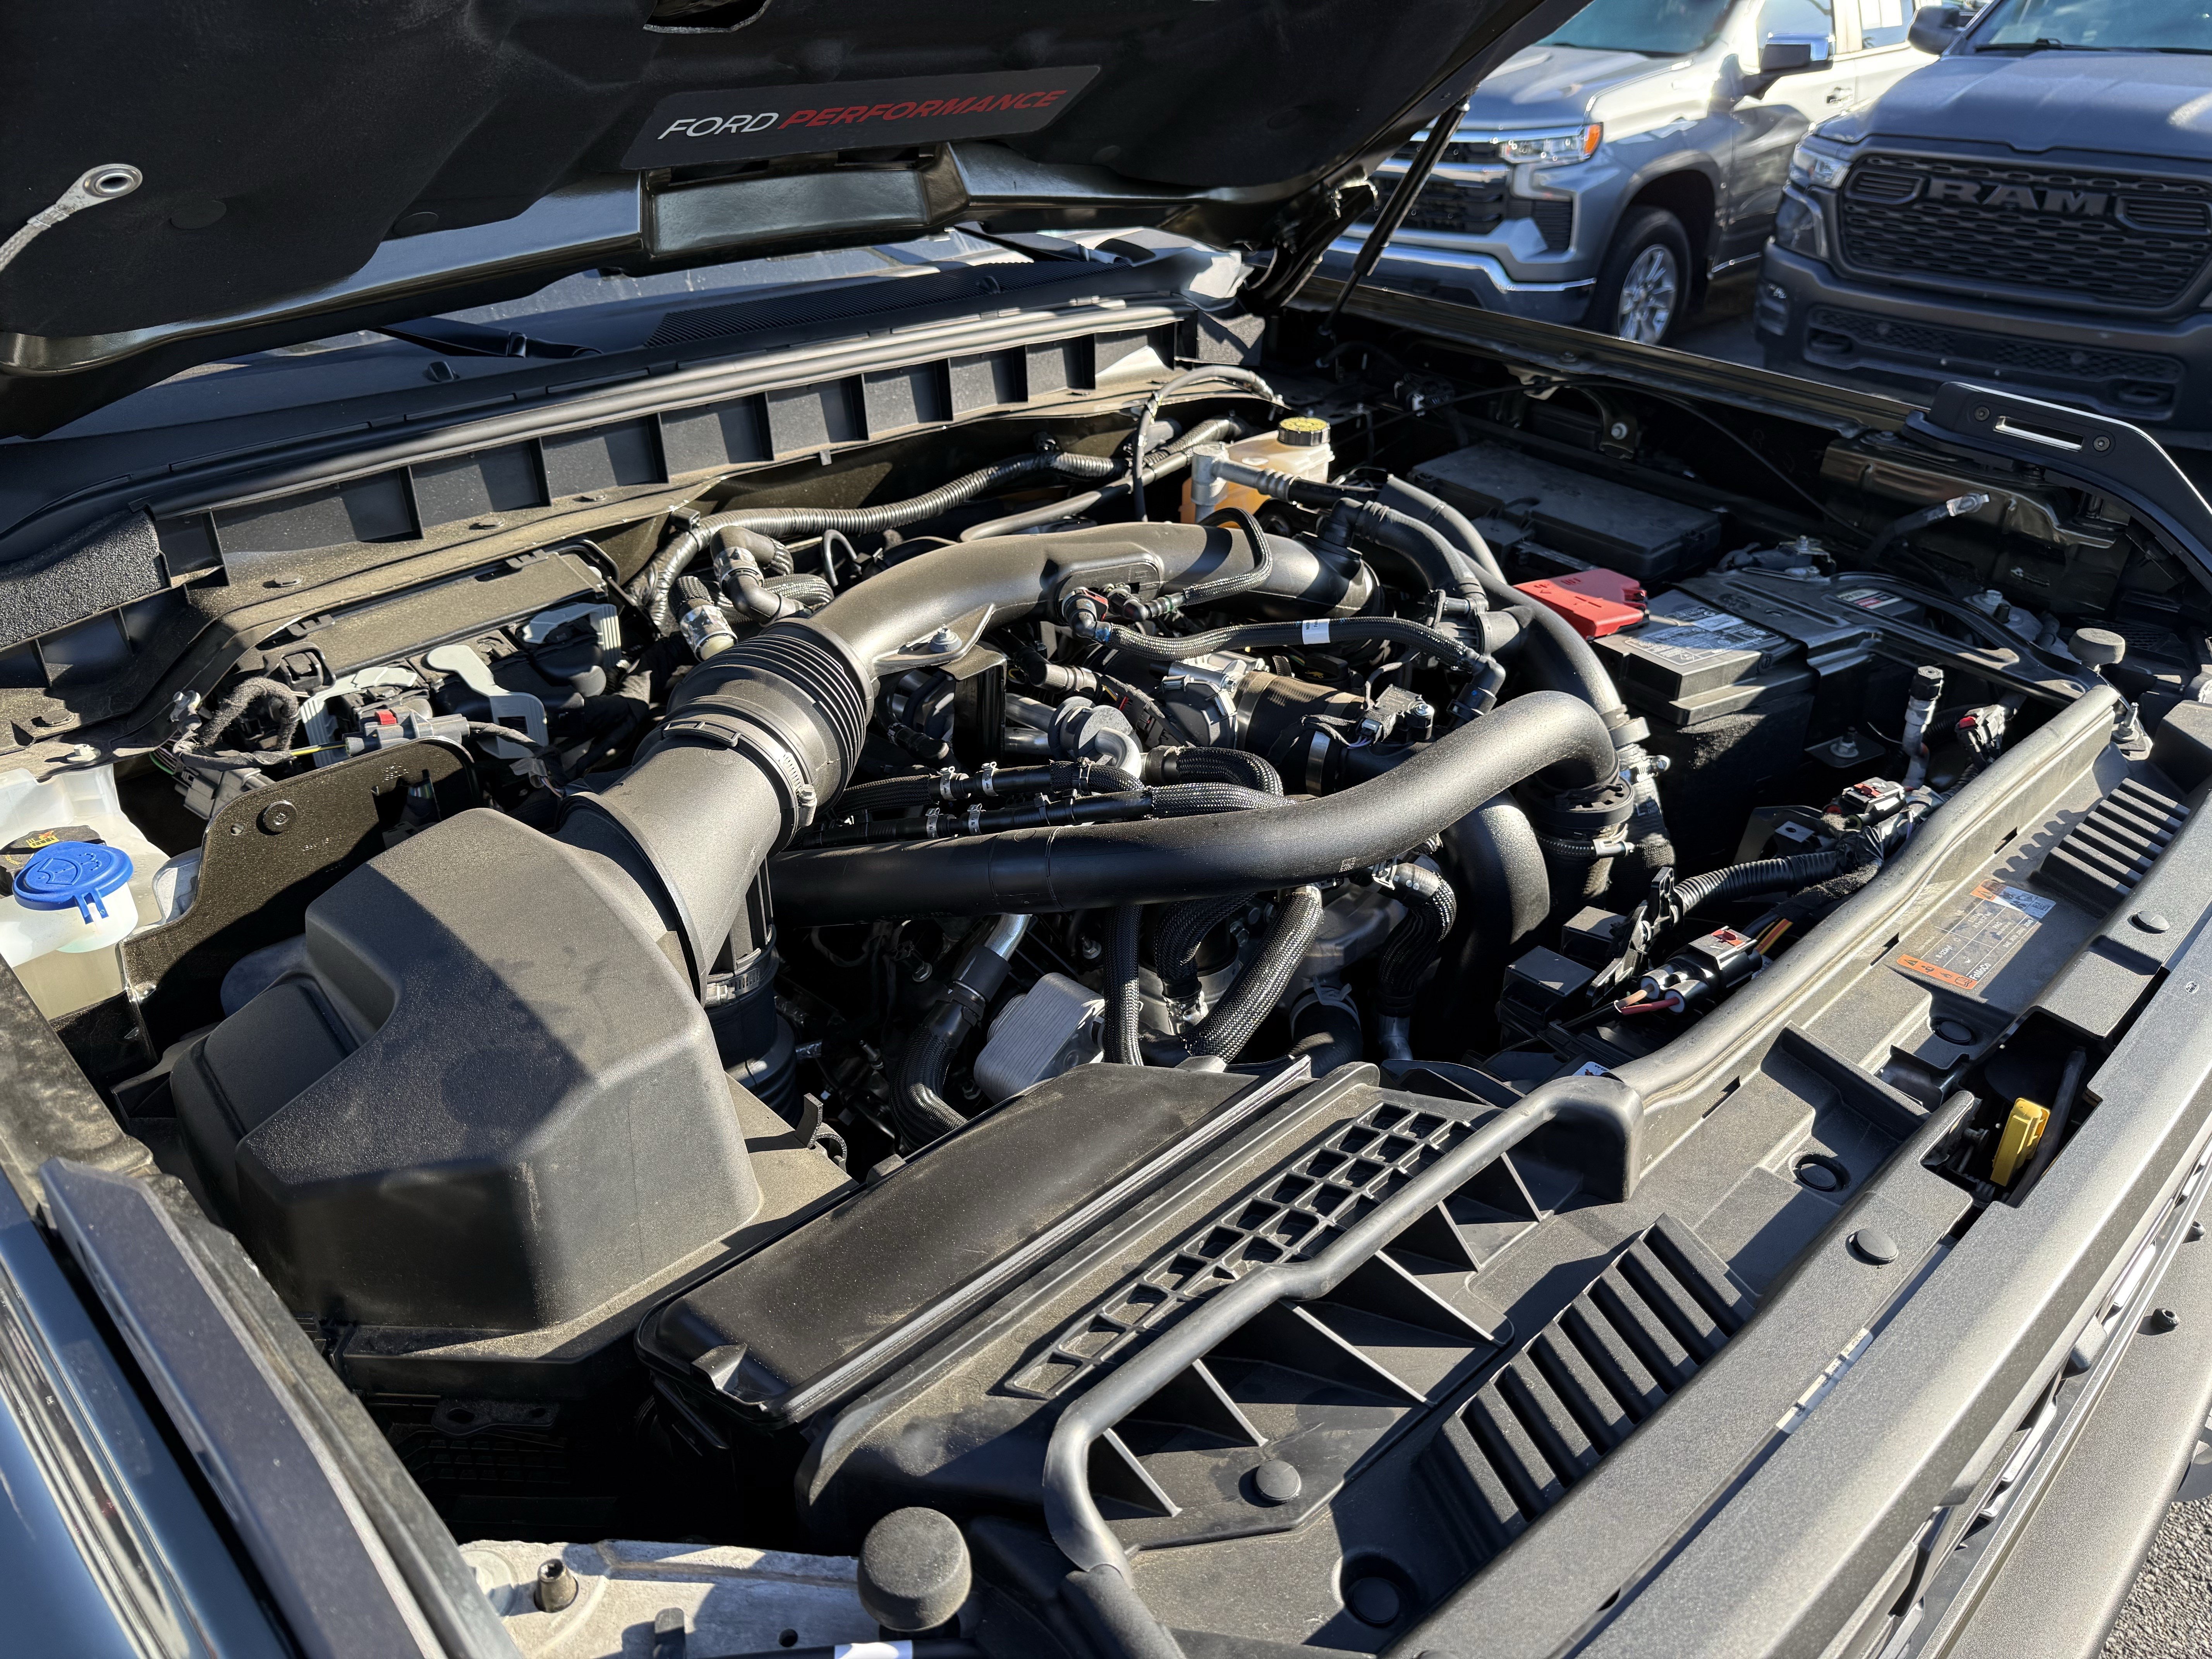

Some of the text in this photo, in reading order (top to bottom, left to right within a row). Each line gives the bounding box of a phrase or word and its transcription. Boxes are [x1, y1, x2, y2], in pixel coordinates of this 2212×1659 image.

[657, 89, 1067, 140] FORD PERFORMANCE
[1925, 177, 2108, 215] RAM
[1969, 963, 1992, 981] FoMoCo
